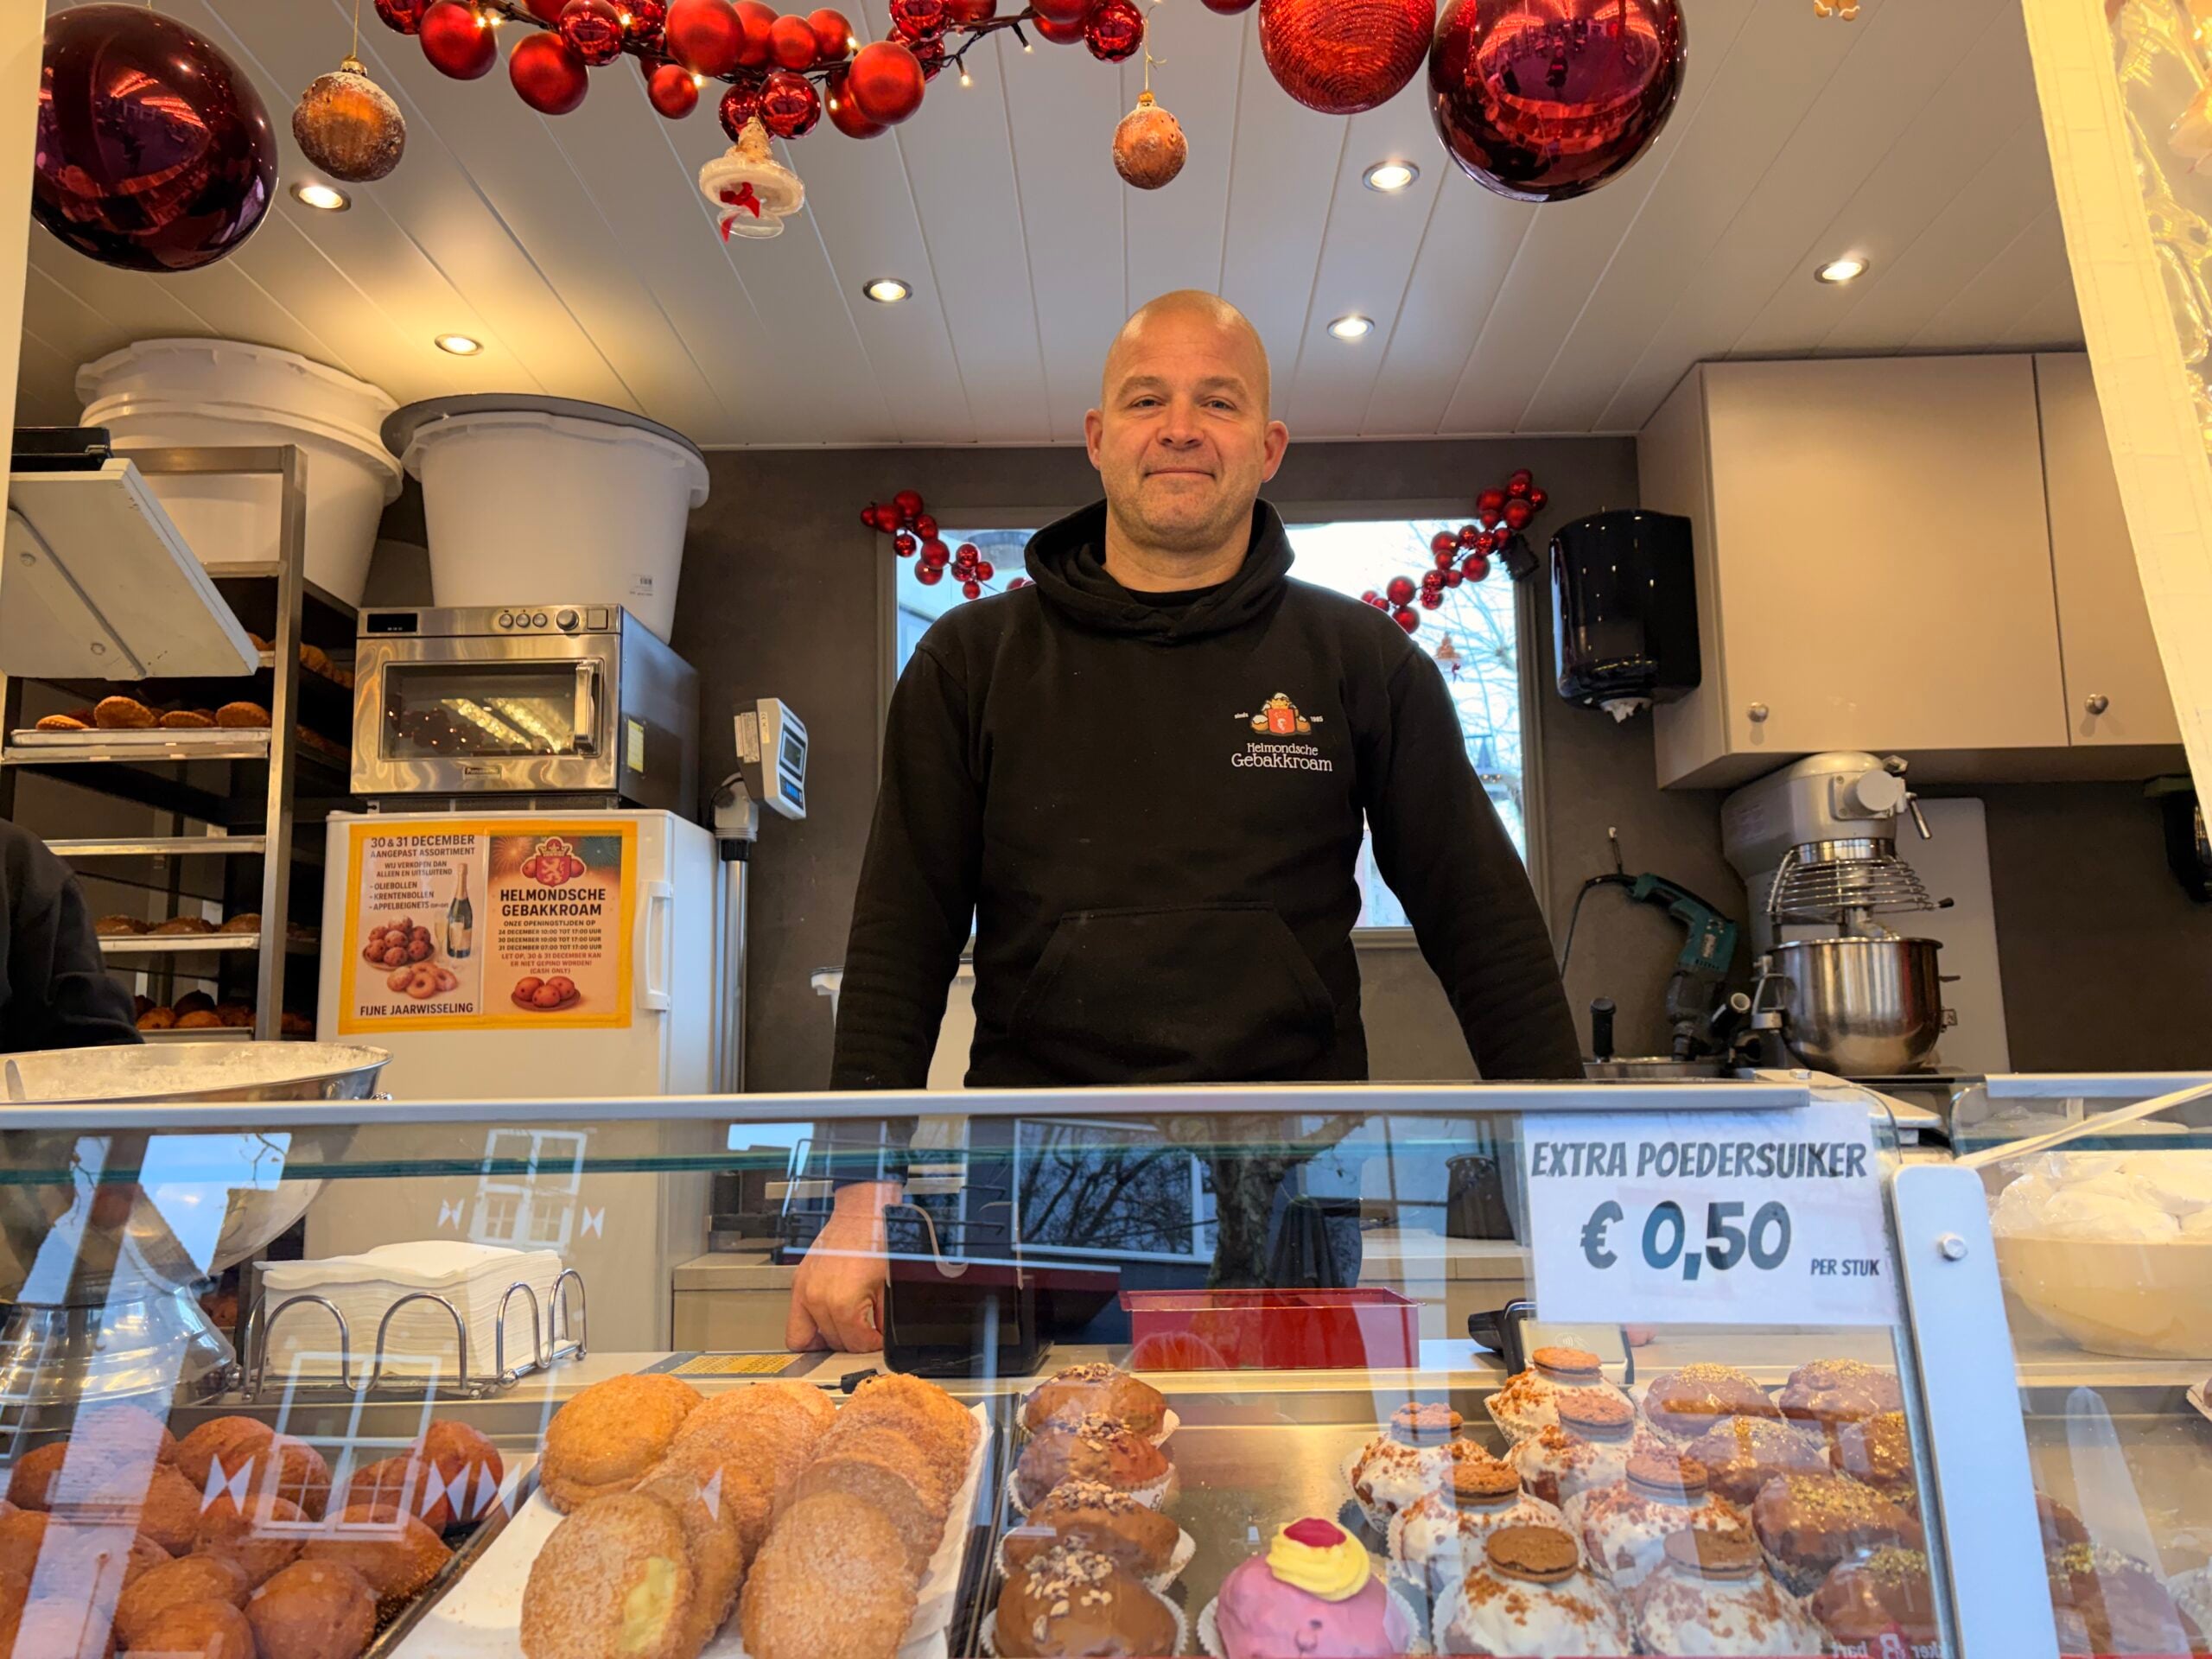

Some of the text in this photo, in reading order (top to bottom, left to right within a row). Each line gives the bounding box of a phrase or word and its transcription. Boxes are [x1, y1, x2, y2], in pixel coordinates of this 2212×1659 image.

[1247, 742, 1319, 756] Helmondsche
[1231, 753, 1332, 772] Gebakkroam
[371, 835, 474, 848] 30 & 31 DECEMBER
[371, 847, 475, 858] AANGEPAST ASSORTIMENT
[374, 881, 417, 890] OLIEBOLLEN
[374, 891, 435, 900] KRENTENBOLLEN
[500, 888, 607, 902] HELMONDSCHE
[373, 901, 429, 911] APPELBEIGNETS
[502, 904, 601, 917] GEBAKKROAM
[360, 1002, 474, 1016] FIJNE JAARWISSELING
[1531, 1141, 1867, 1179] EXTRA POEDERSUIKER
[1580, 1199, 1791, 1281] € 0,50
[1811, 1259, 1879, 1276] PER STUK
